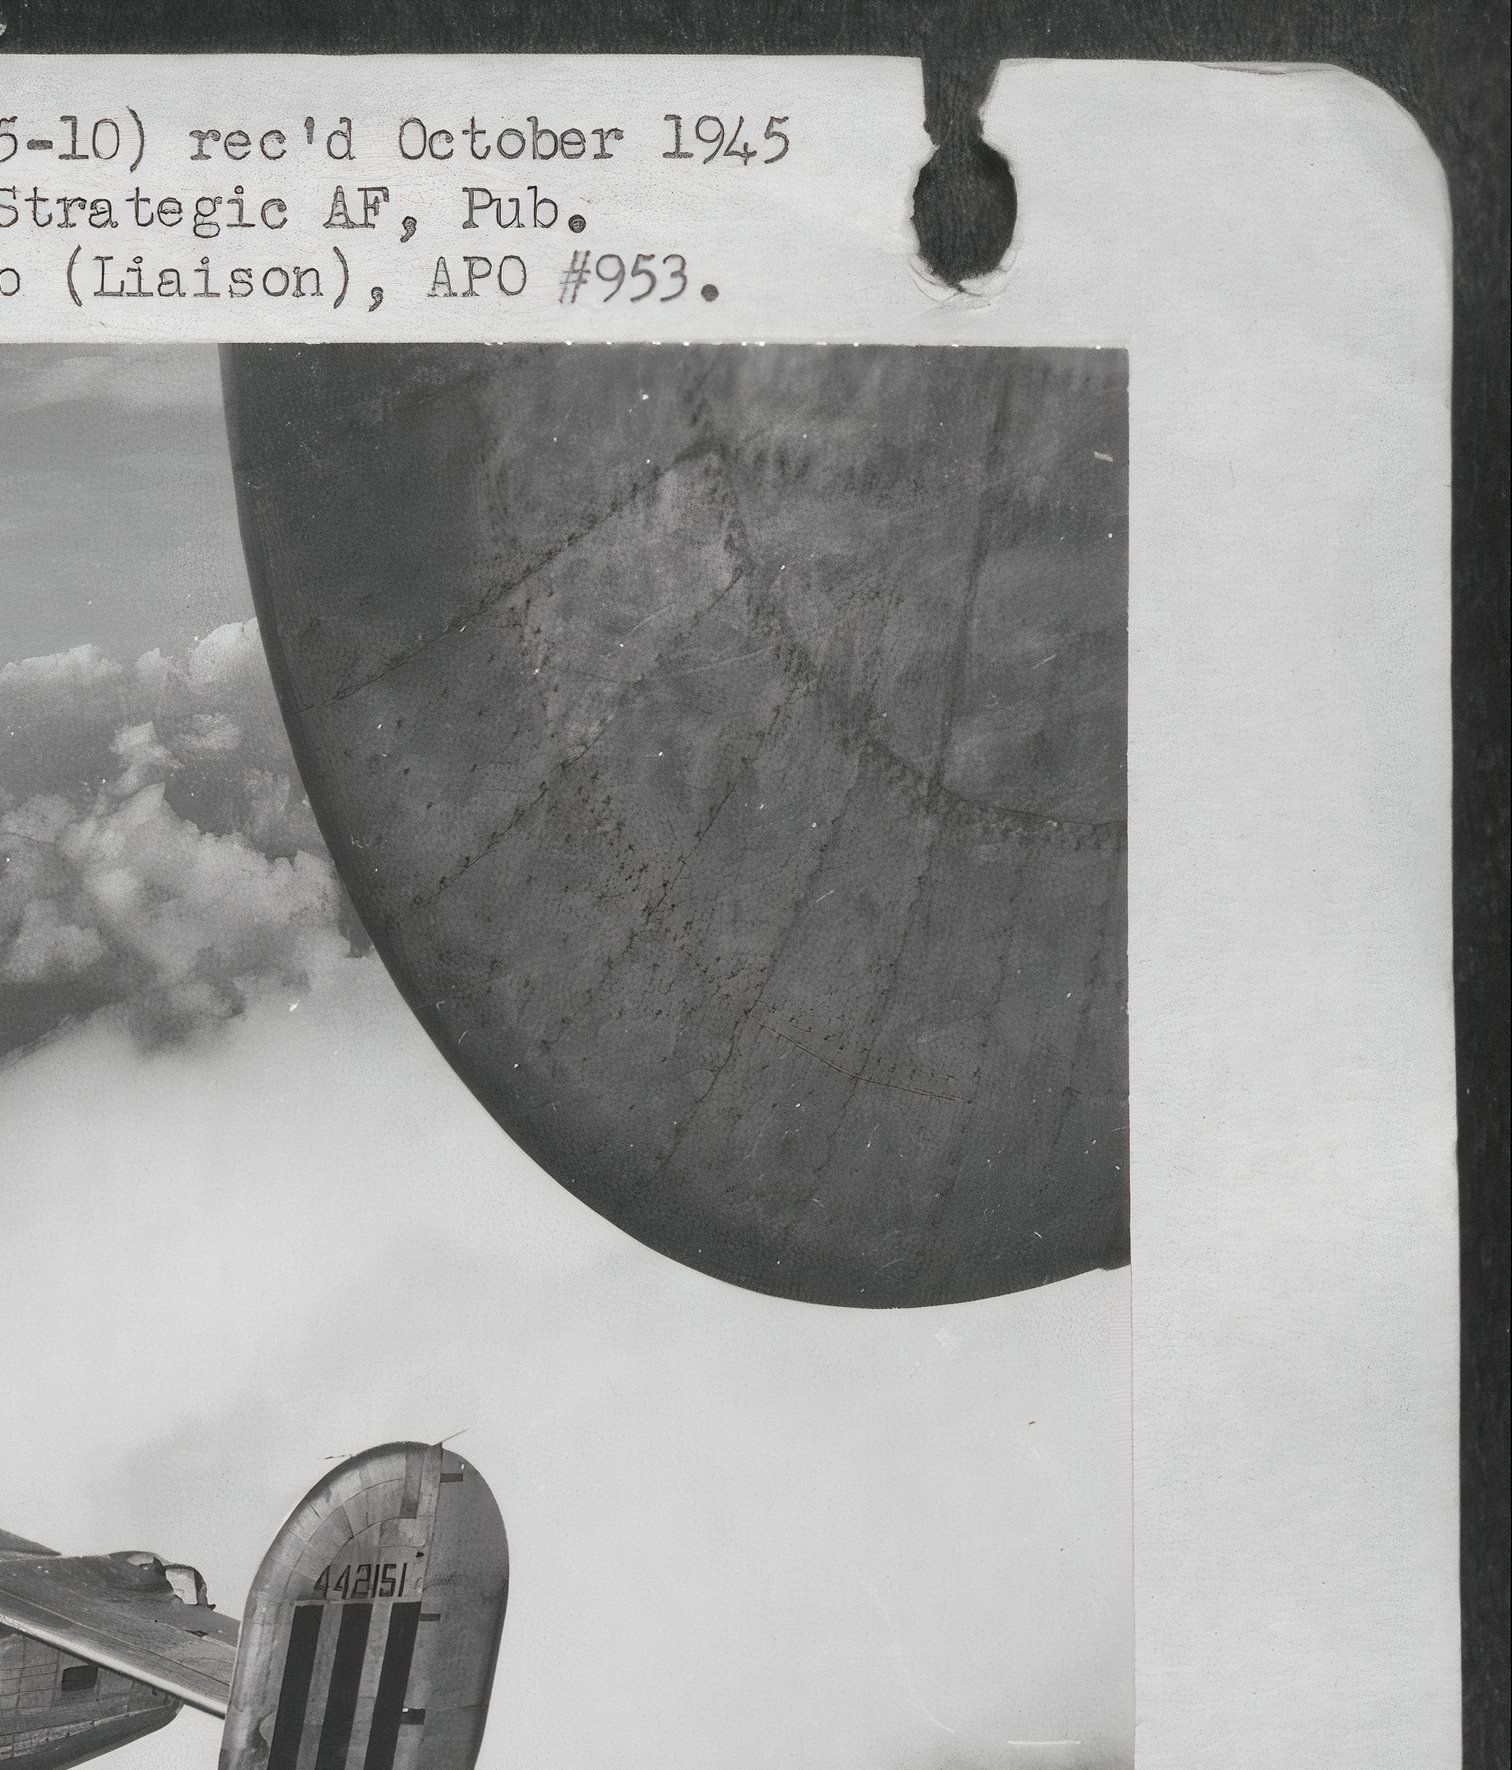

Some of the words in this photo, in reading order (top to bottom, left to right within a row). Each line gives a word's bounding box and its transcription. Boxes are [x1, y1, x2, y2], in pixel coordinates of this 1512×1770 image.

[189, 116, 358, 162] rec'd
[399, 116, 624, 162] October
[663, 114, 791, 166] 1945
[323, 185, 419, 243] AF,
[462, 185, 590, 233] Pub.
[66, 249, 384, 310] (Liaison),
[427, 255, 529, 298] APO
[559, 250, 720, 304] #953.
[313, 1562, 408, 1600] 442151
